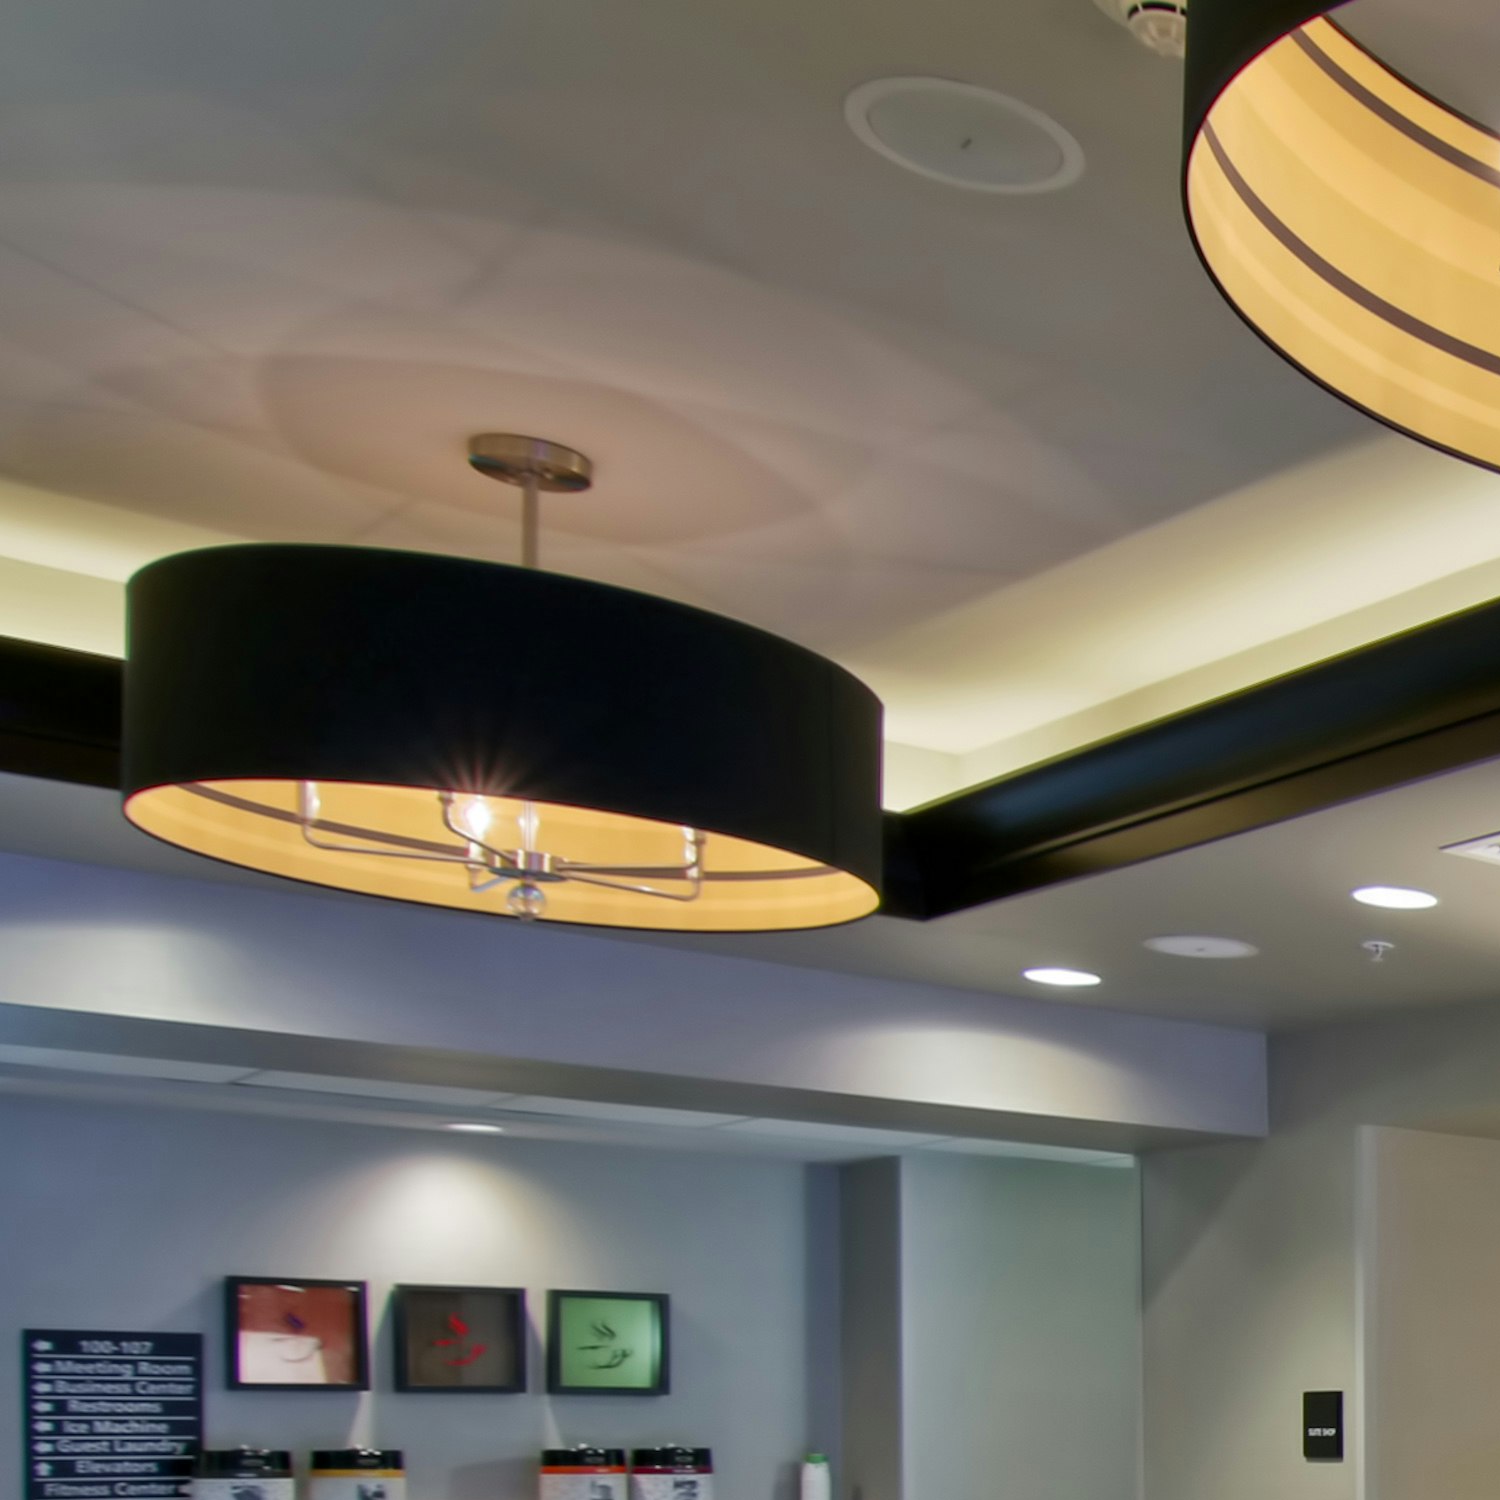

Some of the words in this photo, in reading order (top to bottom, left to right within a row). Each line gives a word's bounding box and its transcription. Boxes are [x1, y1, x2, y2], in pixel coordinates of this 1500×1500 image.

[79, 1340, 153, 1355] 100-107
[53, 1360, 134, 1377] Meeting
[137, 1361, 192, 1375] Room
[54, 1380, 132, 1394] Business
[135, 1381, 194, 1395] Center
[67, 1400, 163, 1413] Restrooms
[63, 1420, 89, 1433] Ice
[93, 1420, 169, 1434] Machine
[56, 1439, 110, 1453] Guest
[113, 1439, 186, 1455] Laundry
[75, 1460, 159, 1473] Elevators
[44, 1483, 111, 1496] Fitness
[114, 1482, 176, 1496] Center
